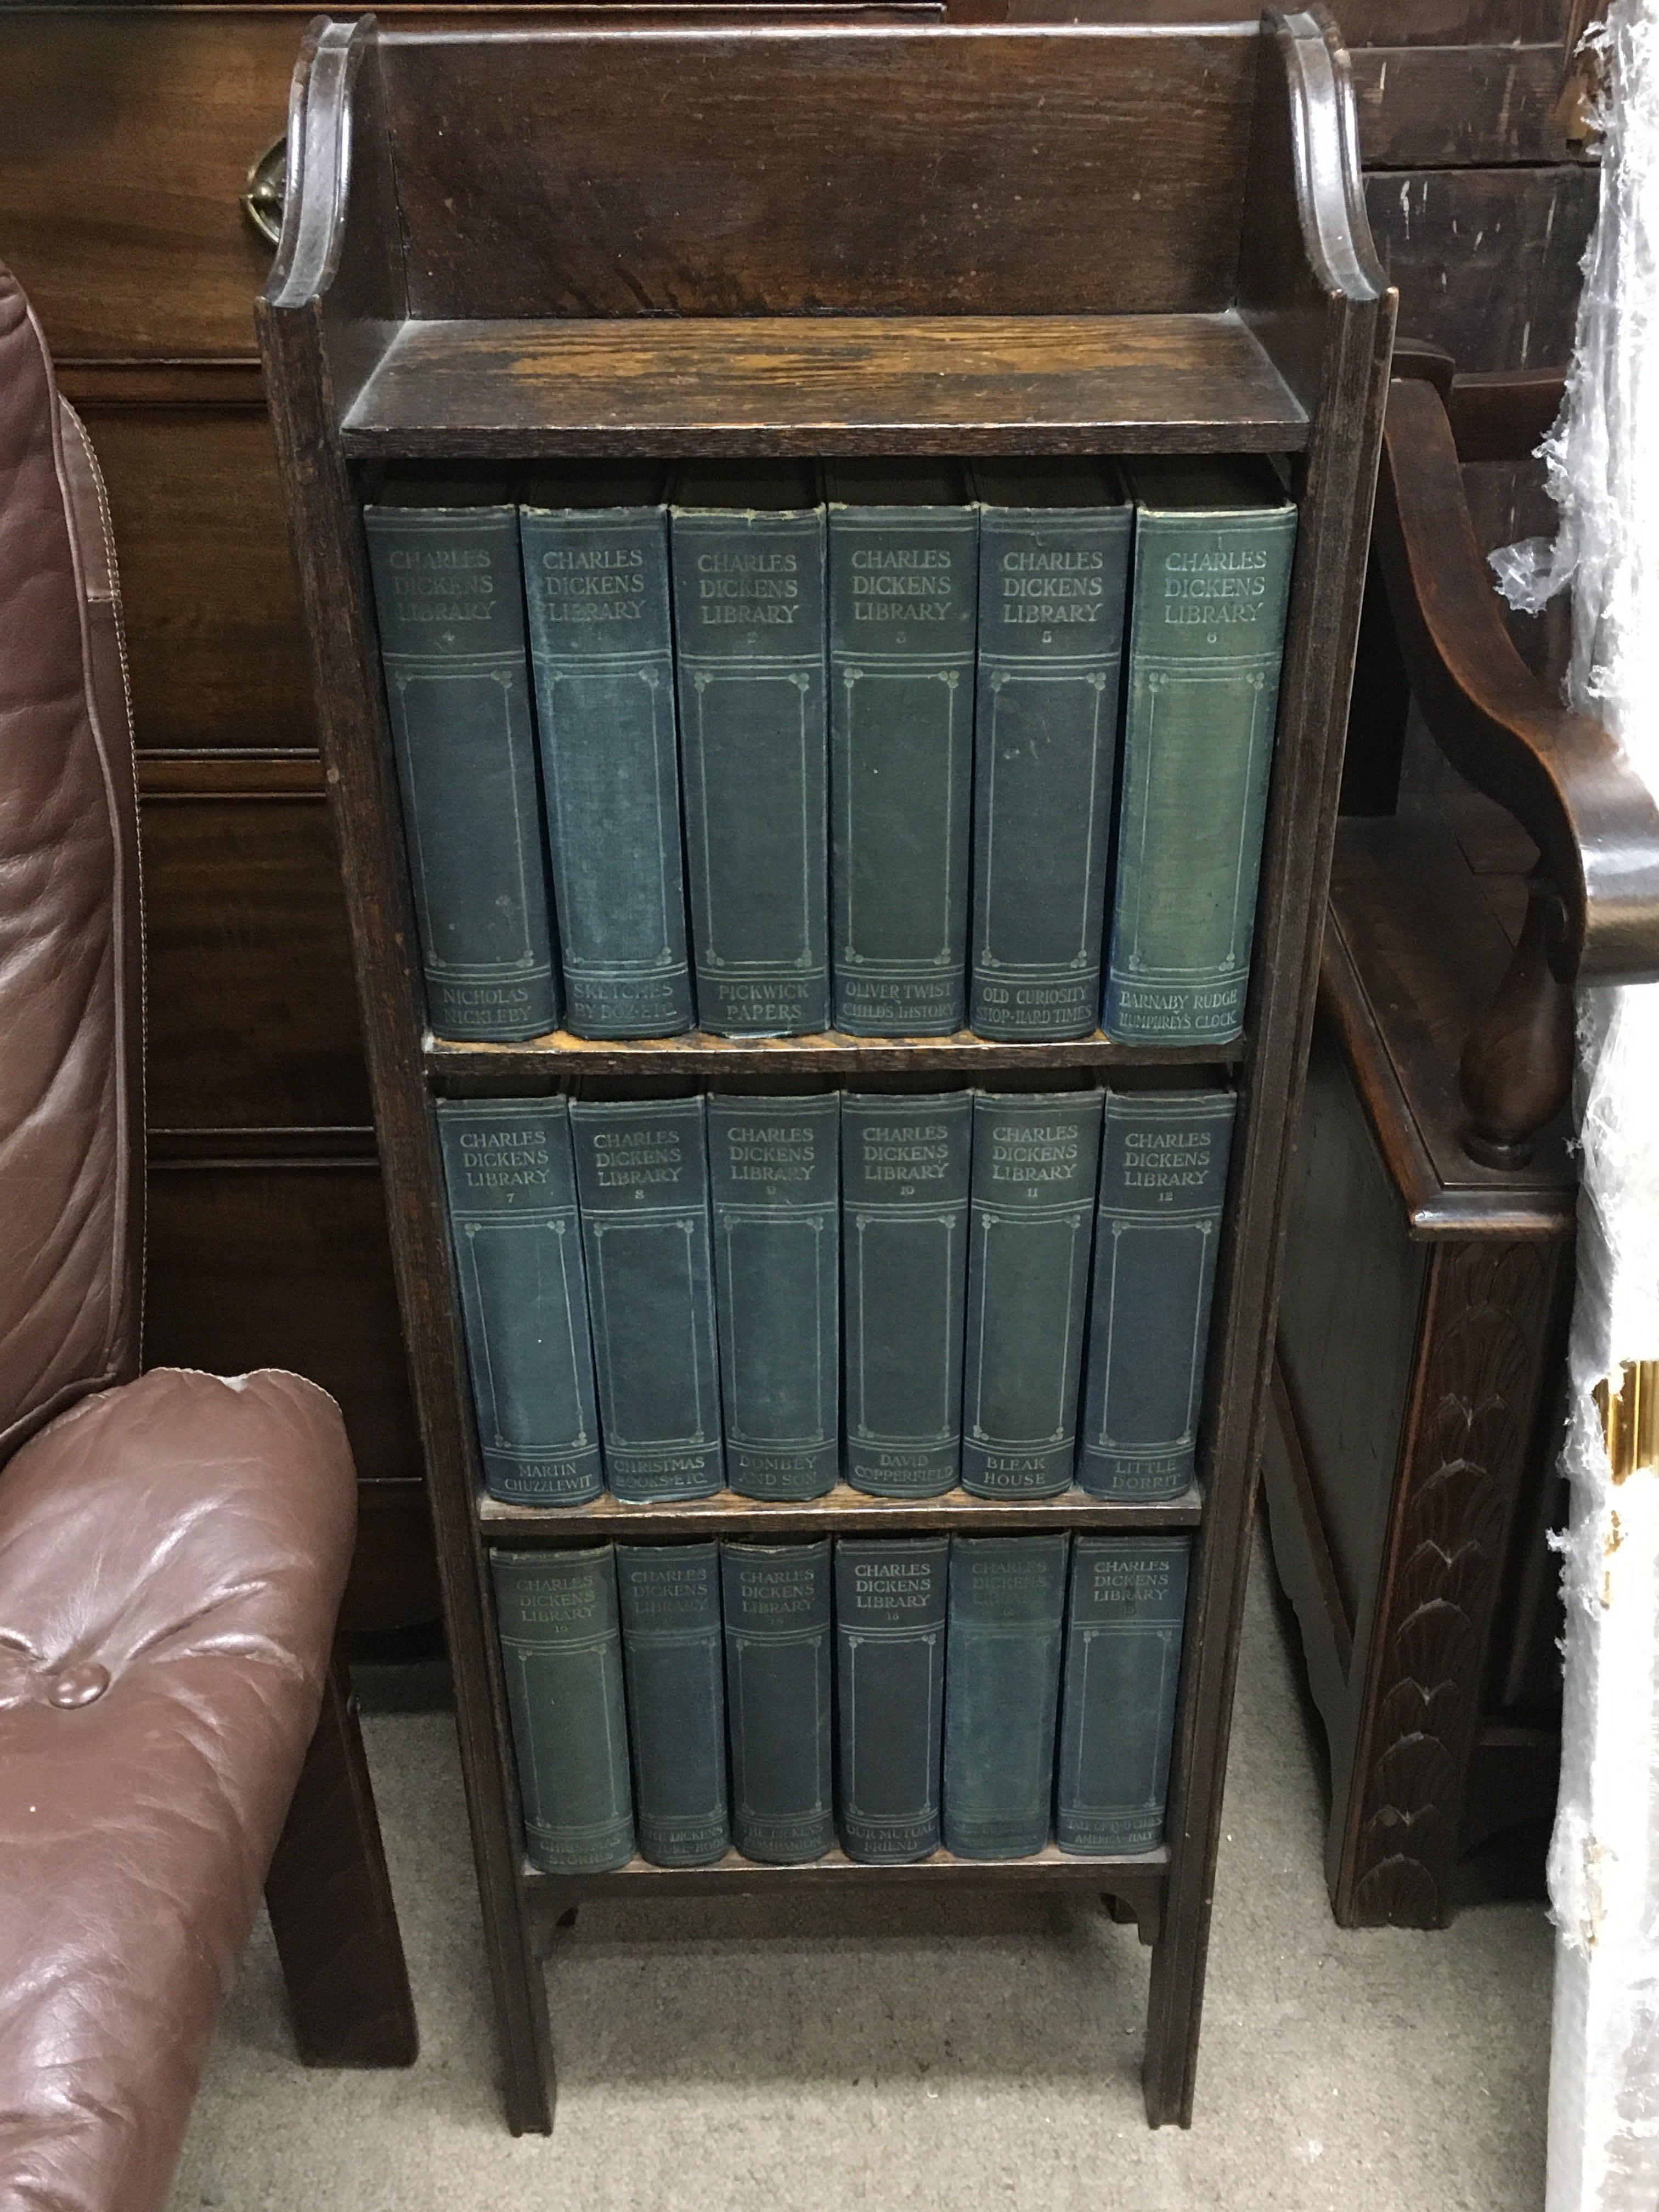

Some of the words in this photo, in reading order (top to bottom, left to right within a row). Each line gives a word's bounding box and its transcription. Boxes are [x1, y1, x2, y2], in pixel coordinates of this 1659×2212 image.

[543, 550, 643, 570] CHARLES
[697, 554, 797, 573] CHARLES
[851, 550, 951, 569] CHARLES
[1003, 551, 1103, 571] CHARLES
[1166, 550, 1267, 572] CHARLES
[547, 574, 645, 595] DICKENS
[699, 579, 798, 598] DICKENS
[853, 576, 951, 595] DICKENS
[1004, 577, 1103, 597] DICKENS
[1165, 576, 1265, 597] DICKENS
[549, 600, 646, 621] LIBRARY
[702, 605, 799, 624] LIBRARY
[854, 602, 952, 620] LIBRARY
[1003, 603, 1103, 623] LIBRARY
[1165, 602, 1263, 623] LIBRARY
[1042, 631, 1052, 642] 5
[1207, 633, 1217, 643] 6
[443, 988, 528, 1005] NICHOLAS
[719, 983, 809, 1001] PICKWICK
[845, 981, 899, 998] OLIVER
[904, 982, 955, 998] TWIST
[983, 986, 1009, 1005] OLD
[1016, 987, 1087, 1005] CURIOSITY
[1119, 991, 1189, 1009] BARNABY
[1193, 989, 1238, 1009] RUDGE
[444, 1006, 532, 1025] NICKLEBY
[574, 1003, 599, 1019] BY
[727, 1005, 802, 1022] PAPERS
[1054, 1005, 1092, 1024] TIMES
[1195, 1010, 1237, 1029] CLOCK
[460, 1130, 546, 1148] CHARLES
[594, 1131, 680, 1148] CHARLES
[727, 1127, 814, 1143] CHARLES
[863, 1126, 947, 1142] CHARLES
[992, 1125, 1078, 1142] CHARLES
[1125, 1132, 1211, 1148] CHARLES
[465, 1150, 549, 1167] DICKENS
[596, 1148, 681, 1167] DICKENS
[730, 1147, 814, 1161] DICKENS
[864, 1144, 948, 1161] DICKENS
[992, 1144, 1077, 1162] DICKENS
[1124, 1151, 1210, 1168] DICKENS
[467, 1169, 549, 1187] LIBRARY
[599, 1167, 682, 1186] LIBRARY
[731, 1165, 815, 1181] LIBRARY
[865, 1163, 949, 1180] LIBRARY
[992, 1163, 1077, 1182] LIBRARY
[1124, 1170, 1209, 1187] LIBRARY
[506, 1193, 515, 1203] 7
[635, 1190, 645, 1199] 8
[901, 1186, 915, 1195] 10
[1028, 1188, 1038, 1198] 11
[1159, 1192, 1173, 1201] 12
[614, 1456, 705, 1474] CHRISTMAS
[740, 1455, 817, 1470] DOMBEY
[880, 1454, 929, 1467] DAVID
[987, 1458, 1046, 1471] BLEAK
[1115, 1459, 1177, 1474] LITTLE
[518, 1462, 577, 1478] MARTIN
[738, 1472, 777, 1486] AND
[782, 1471, 817, 1486] SON
[854, 1465, 953, 1482] COPPERFIELD
[984, 1471, 1046, 1486] HOUSE
[504, 1474, 593, 1492] CHUZZLEWIT
[1113, 1474, 1182, 1489] DORRIT
[854, 1564, 931, 1577] CHARLES
[1093, 1561, 1170, 1573] CHARLES
[516, 1576, 594, 1592] CHARLES
[630, 1569, 707, 1583] CHARLES
[740, 1569, 815, 1584] CHARLES
[1094, 1574, 1169, 1588] DICKENS
[741, 1583, 815, 1599] DICKENS
[856, 1578, 931, 1592] DICKENS
[520, 1590, 595, 1607] DICKENS
[856, 1593, 932, 1608] LIBRARY
[1093, 1589, 1168, 1602] LIBRARY
[522, 1605, 595, 1622] LIBRARY
[742, 1598, 815, 1613] LIBRARY
[847, 1824, 876, 1839] OUR
[878, 1822, 935, 1839] MUTUAL
[864, 1841, 918, 1852] FRIEND
